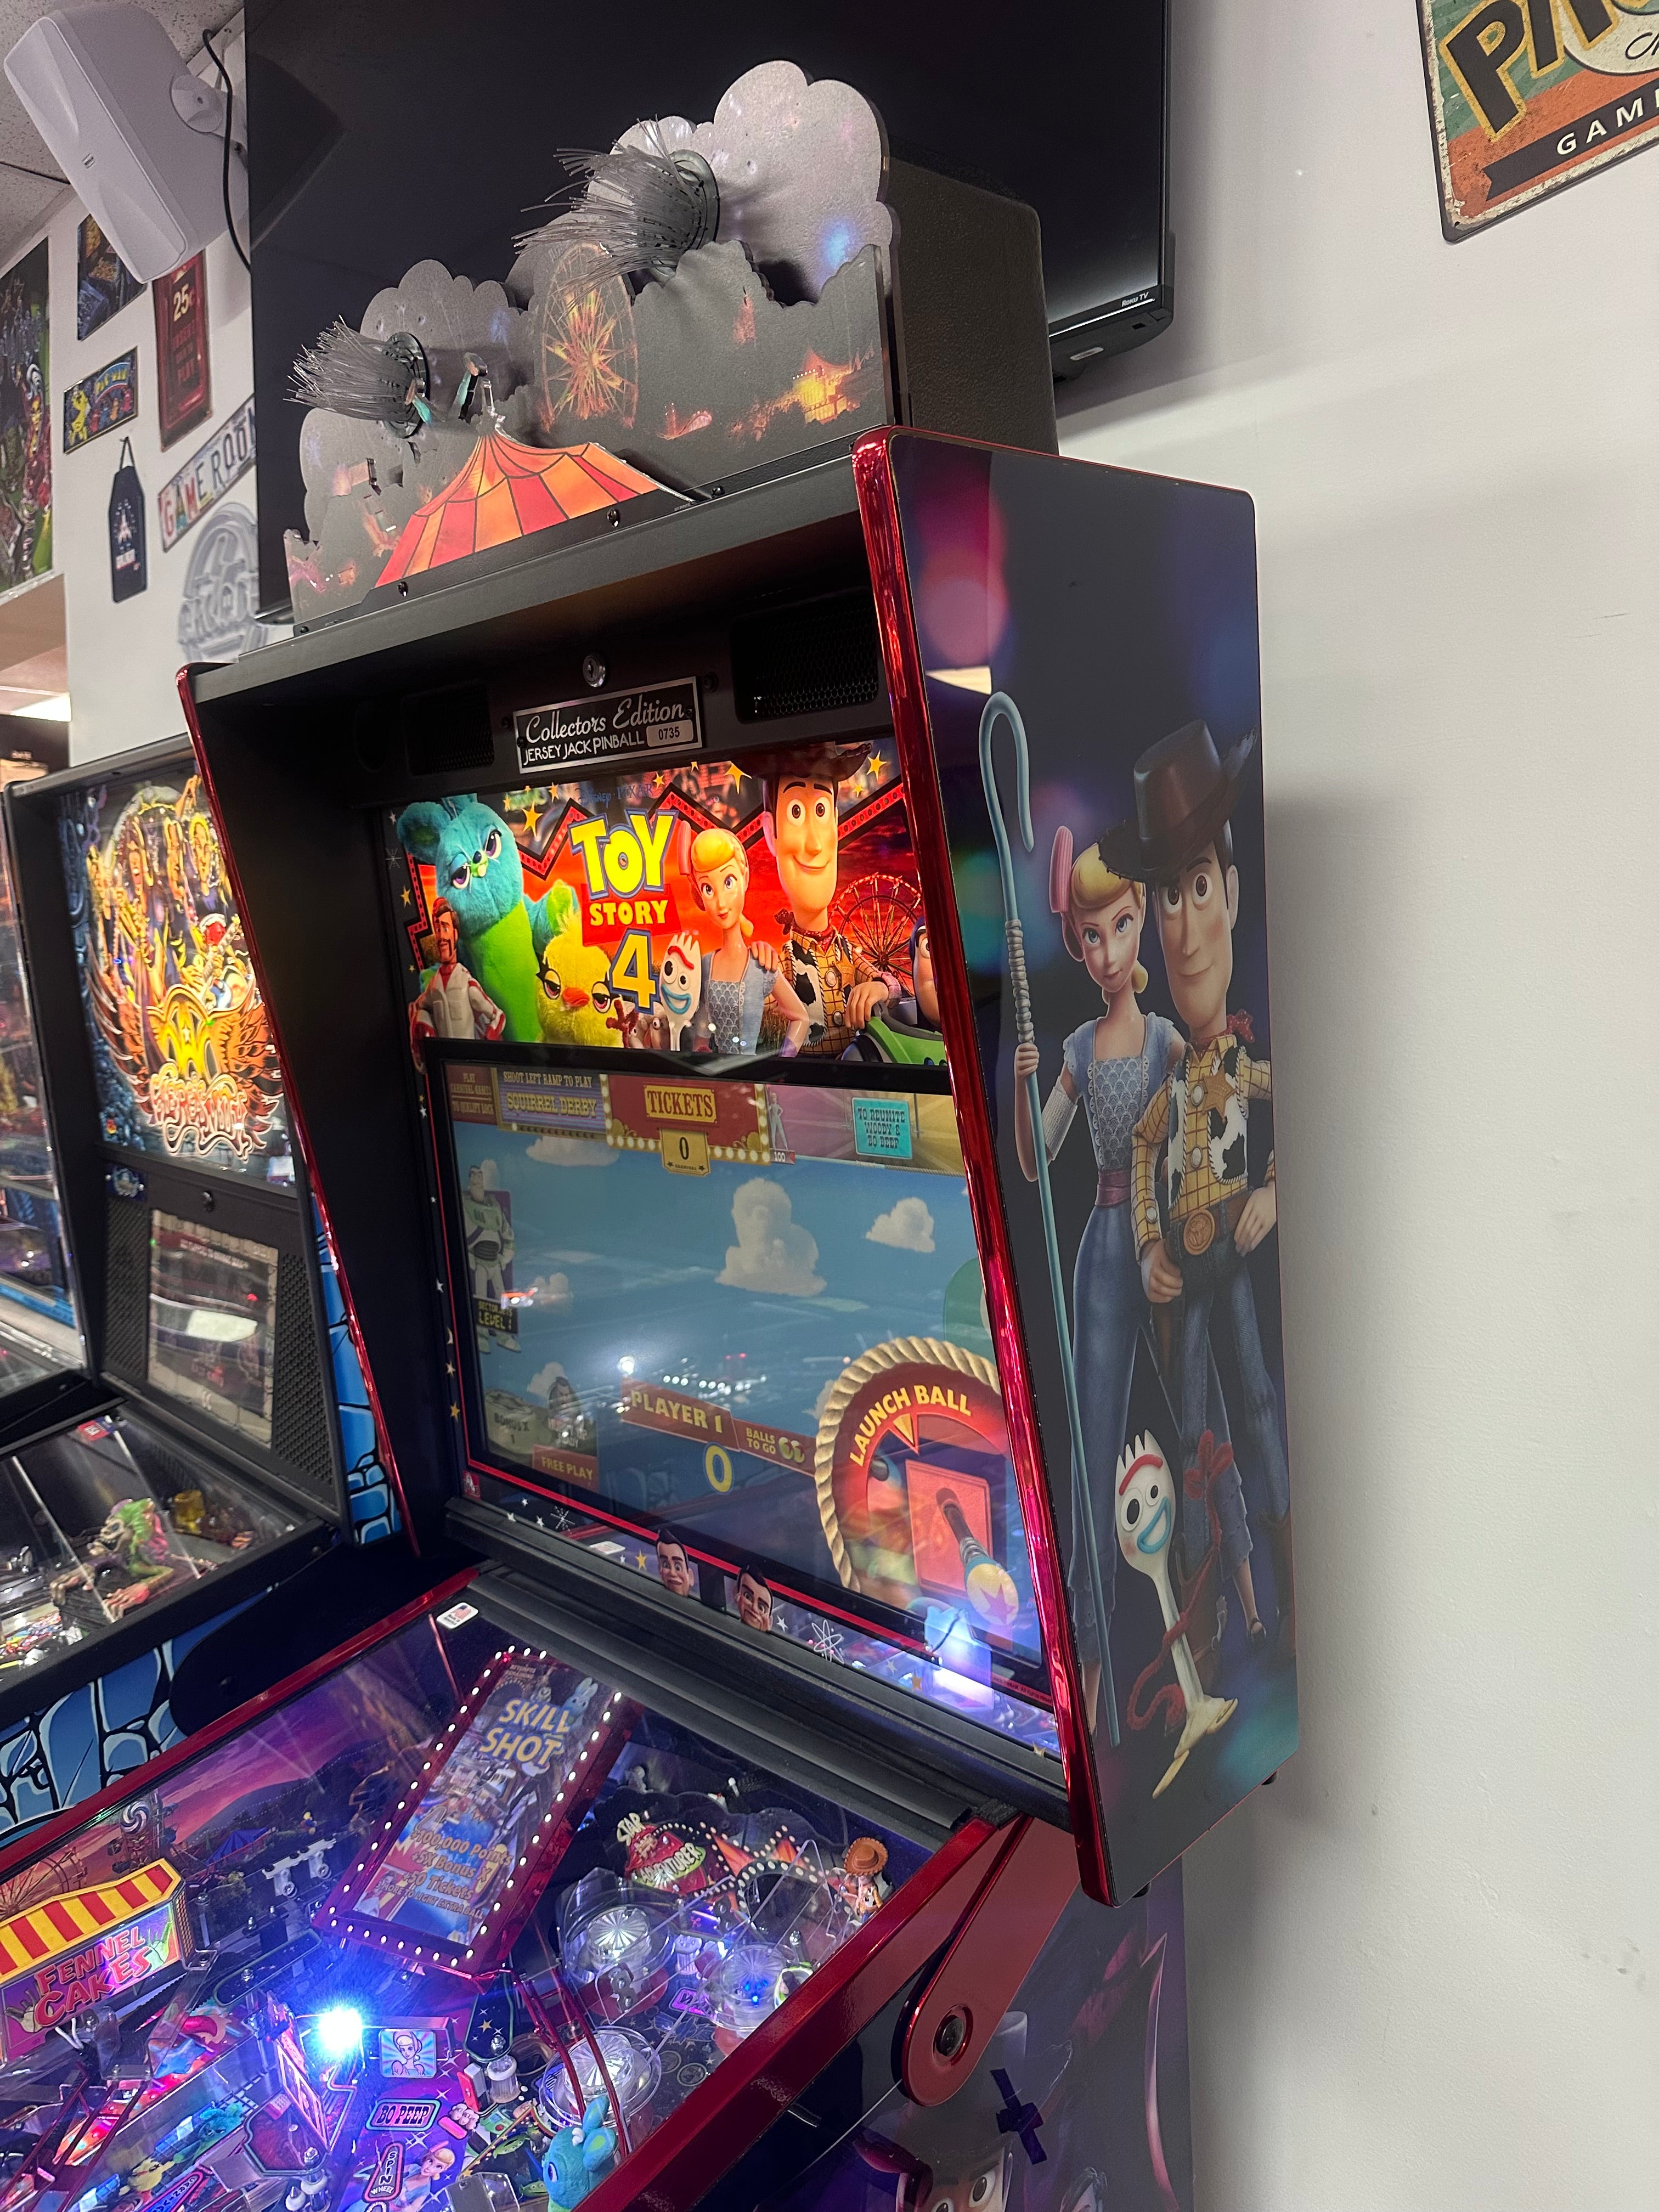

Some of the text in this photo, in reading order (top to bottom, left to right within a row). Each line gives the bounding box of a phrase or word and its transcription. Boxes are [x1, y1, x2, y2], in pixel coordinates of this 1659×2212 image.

[1139, 291, 1149, 301] TV
[526, 693, 685, 743] Collectors Edition
[523, 726, 680, 766] JERSEY JACK PINBALL 0735
[567, 808, 680, 900] TOY
[589, 900, 669, 927] STORY
[608, 927, 659, 1015] 4
[503, 1071, 592, 1088] SHOOT LEFT RAMP TO PLAY
[506, 1092, 597, 1117] SQUIRREL DERBY
[647, 1090, 713, 1118] TICKETS
[857, 1108, 905, 1123] TO REUNITE
[865, 1121, 892, 1135] WOODY
[774, 1152, 786, 1162] 100
[478, 1311, 506, 1329] LEVEL
[631, 1390, 708, 1429] PLAYER
[849, 1384, 972, 1466] LAUNCH BALL
[746, 1427, 776, 1444] BALLS
[747, 1437, 776, 1454] TO GO
[541, 1456, 593, 1481] FREE PLAY
[498, 1699, 571, 1734] SKILL
[479, 1727, 562, 1766] SHOT
[616, 1812, 647, 1847] STAR
[410, 1829, 514, 1866] +100,000 Points
[639, 1842, 703, 1883] ADVENTURER
[411, 1850, 493, 1883] +5X Bonus X
[382, 1882, 405, 1896] MORE
[404, 1888, 415, 1899] TO
[414, 1891, 439, 1906] LIGHT
[439, 1897, 466, 1914] EXTRA
[465, 1905, 485, 1921] BALL
[402, 1869, 477, 1901] +50 Tickets
[35, 1926, 145, 1996] FENNEL
[33, 1945, 153, 2027] CAKES
[376, 2105, 430, 2125] BO PEEP
[379, 2152, 398, 2185] SPIN
[370, 2186, 394, 2195] WHEEL
